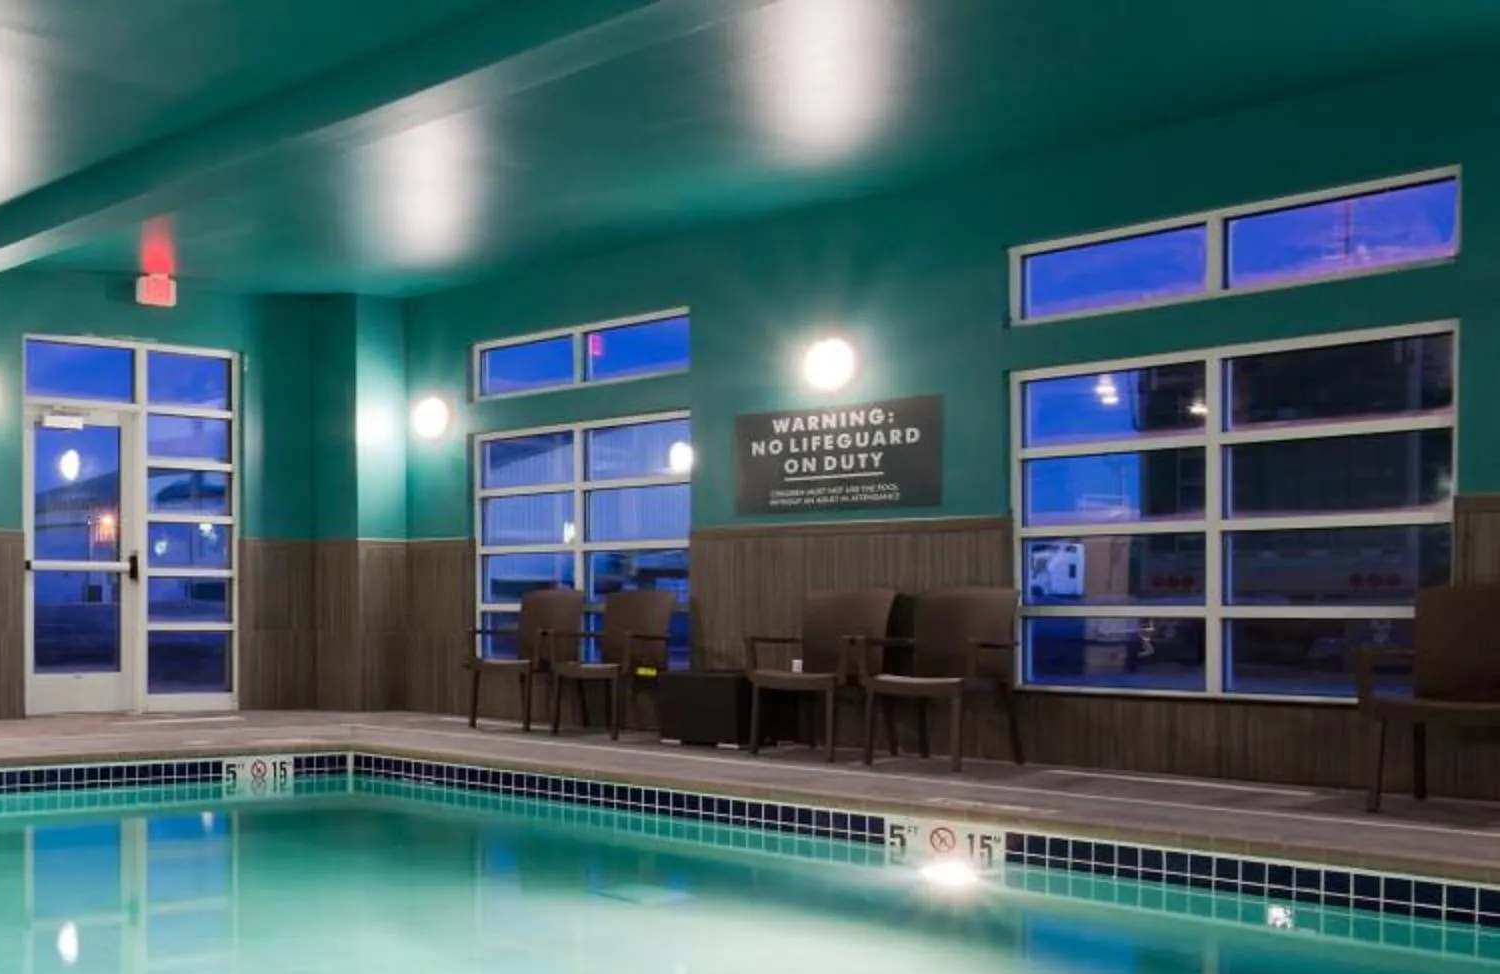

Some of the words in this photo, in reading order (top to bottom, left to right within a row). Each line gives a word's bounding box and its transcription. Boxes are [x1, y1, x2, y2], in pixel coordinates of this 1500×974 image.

[772, 408, 895, 433] WARNING:
[751, 440, 783, 457] NO
[790, 427, 921, 453] LIFEGUARD
[784, 457, 817, 474] ON
[824, 452, 884, 471] DUTY
[889, 824, 907, 847] 5
